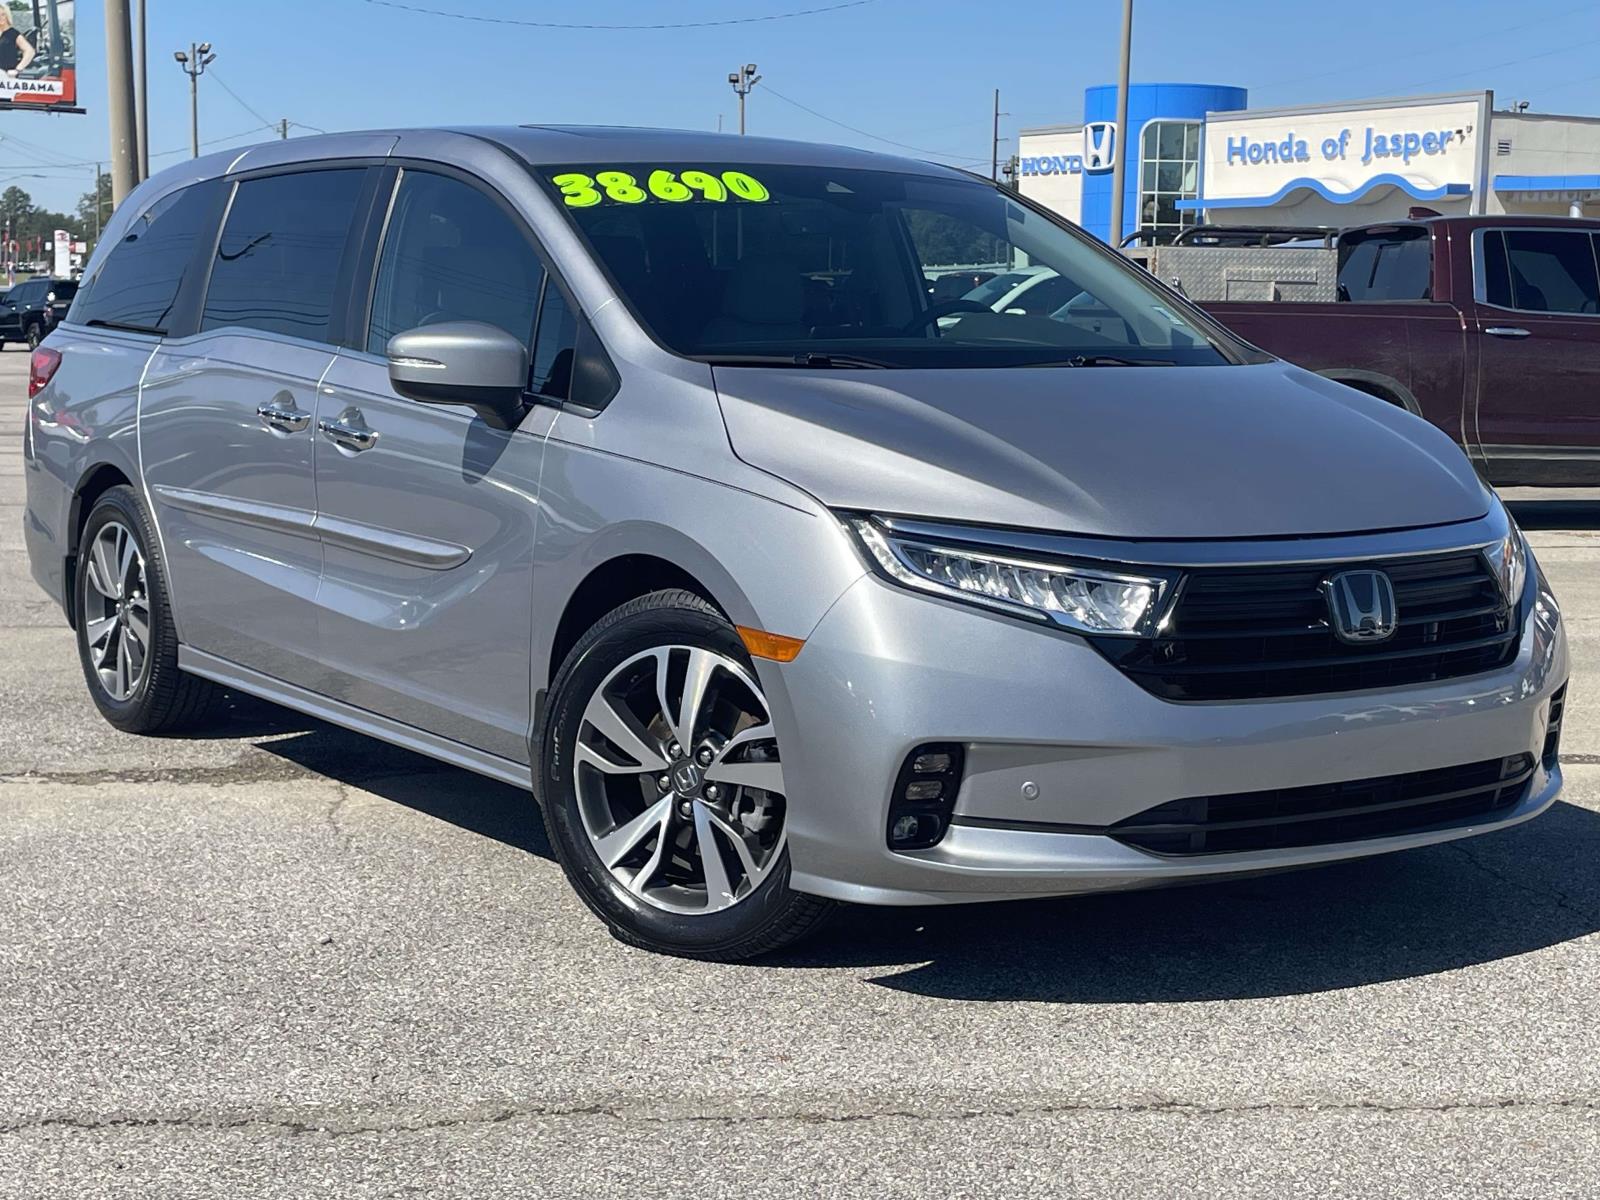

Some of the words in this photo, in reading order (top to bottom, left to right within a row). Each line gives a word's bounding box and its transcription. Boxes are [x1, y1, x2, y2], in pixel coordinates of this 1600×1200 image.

[1227, 132, 1309, 163] Honda
[1321, 128, 1350, 159] of
[1361, 127, 1453, 163] Jasper
[1021, 155, 1082, 176] HOND
[552, 169, 770, 208] 38690
